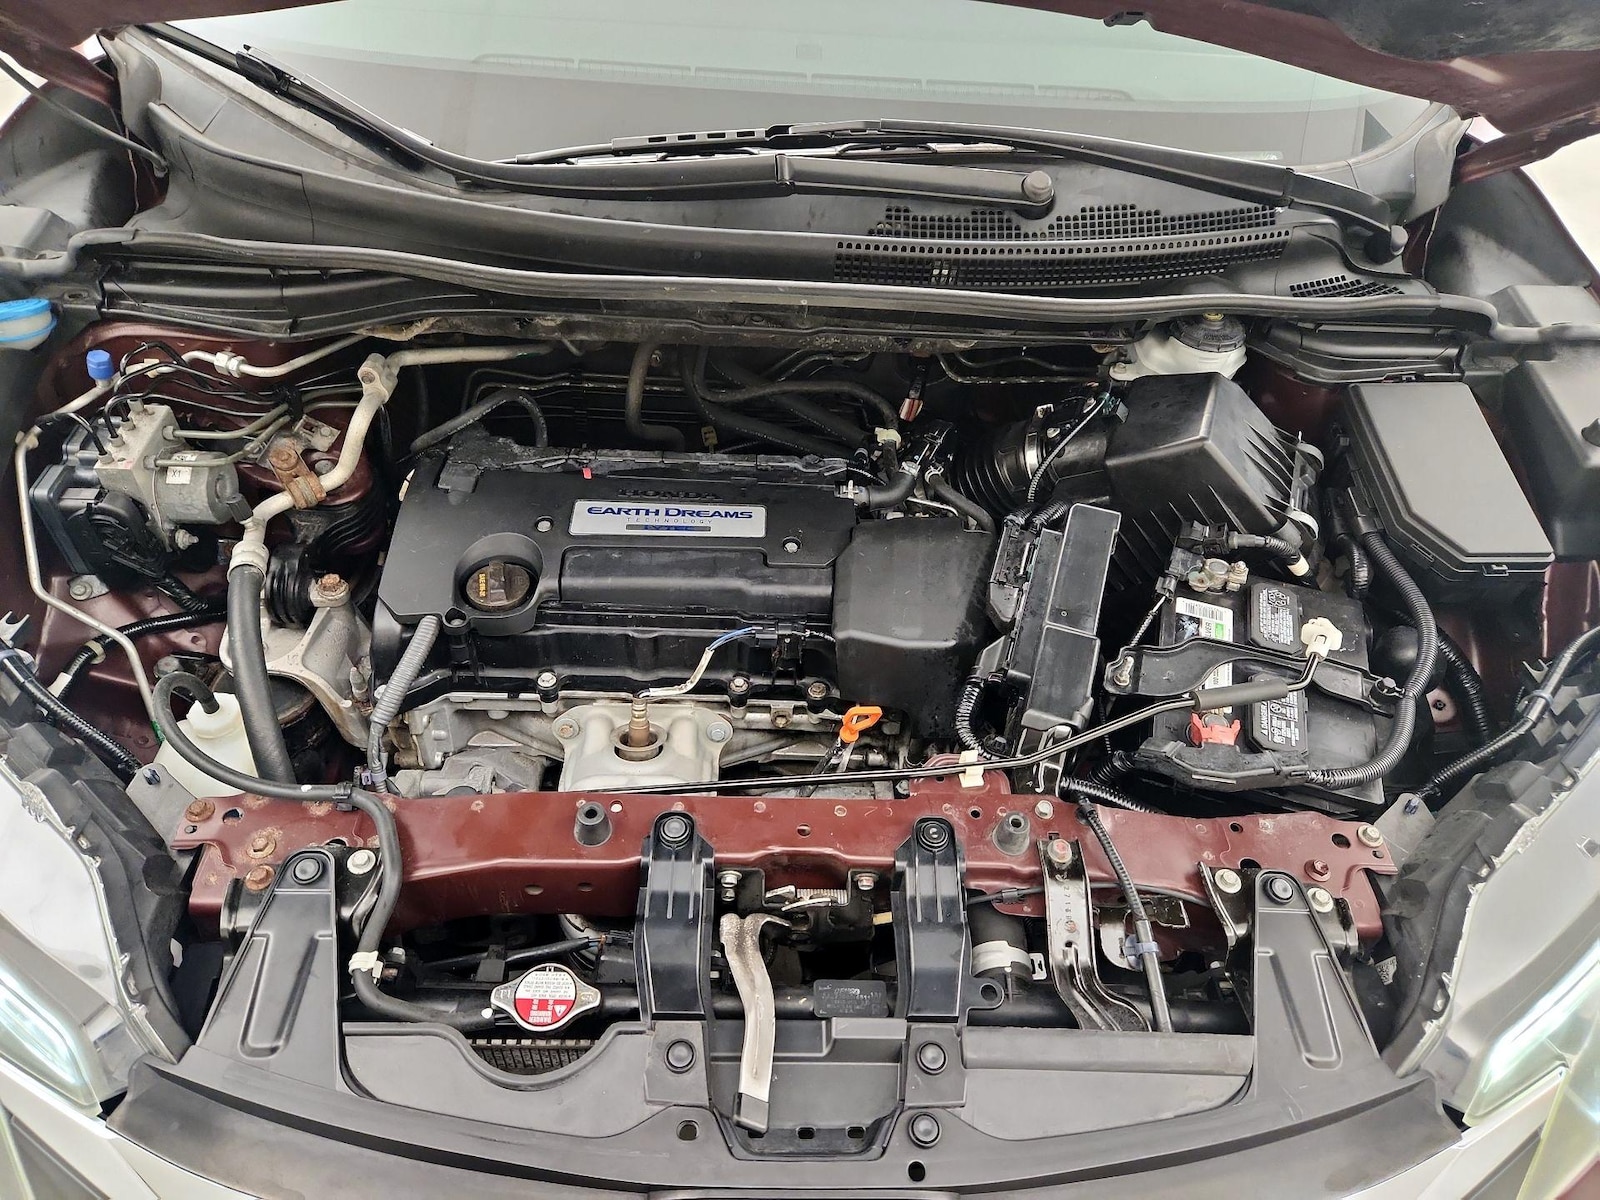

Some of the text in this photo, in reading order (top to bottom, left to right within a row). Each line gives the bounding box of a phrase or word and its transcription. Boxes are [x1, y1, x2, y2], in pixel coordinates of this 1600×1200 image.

[618, 488, 723, 500] HONDA
[587, 506, 753, 519] EARTH DREAMS
[626, 517, 713, 525] TECHNOLOGY
